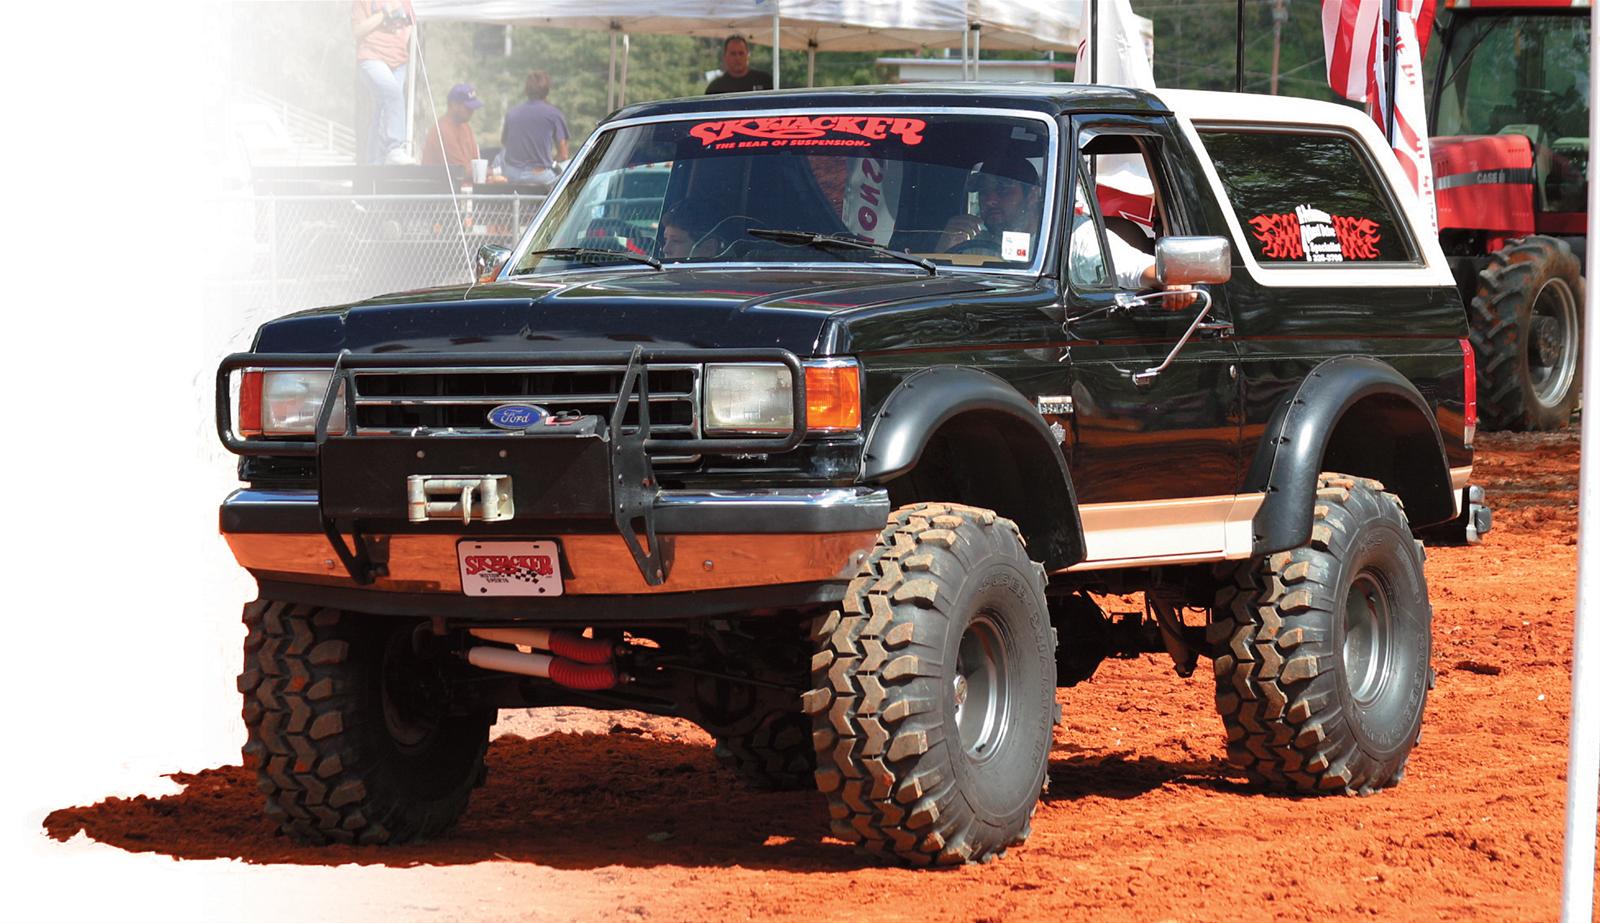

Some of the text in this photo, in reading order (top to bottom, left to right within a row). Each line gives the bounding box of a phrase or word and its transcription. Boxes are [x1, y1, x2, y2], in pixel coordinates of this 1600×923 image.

[689, 116, 927, 145] SKYJACKER
[715, 142, 737, 150] THE
[738, 140, 769, 148] BEAR
[771, 139, 788, 147] OF
[1476, 171, 1498, 184] CASE
[500, 408, 530, 424] Ford
[464, 555, 554, 576] SKYJACKER
